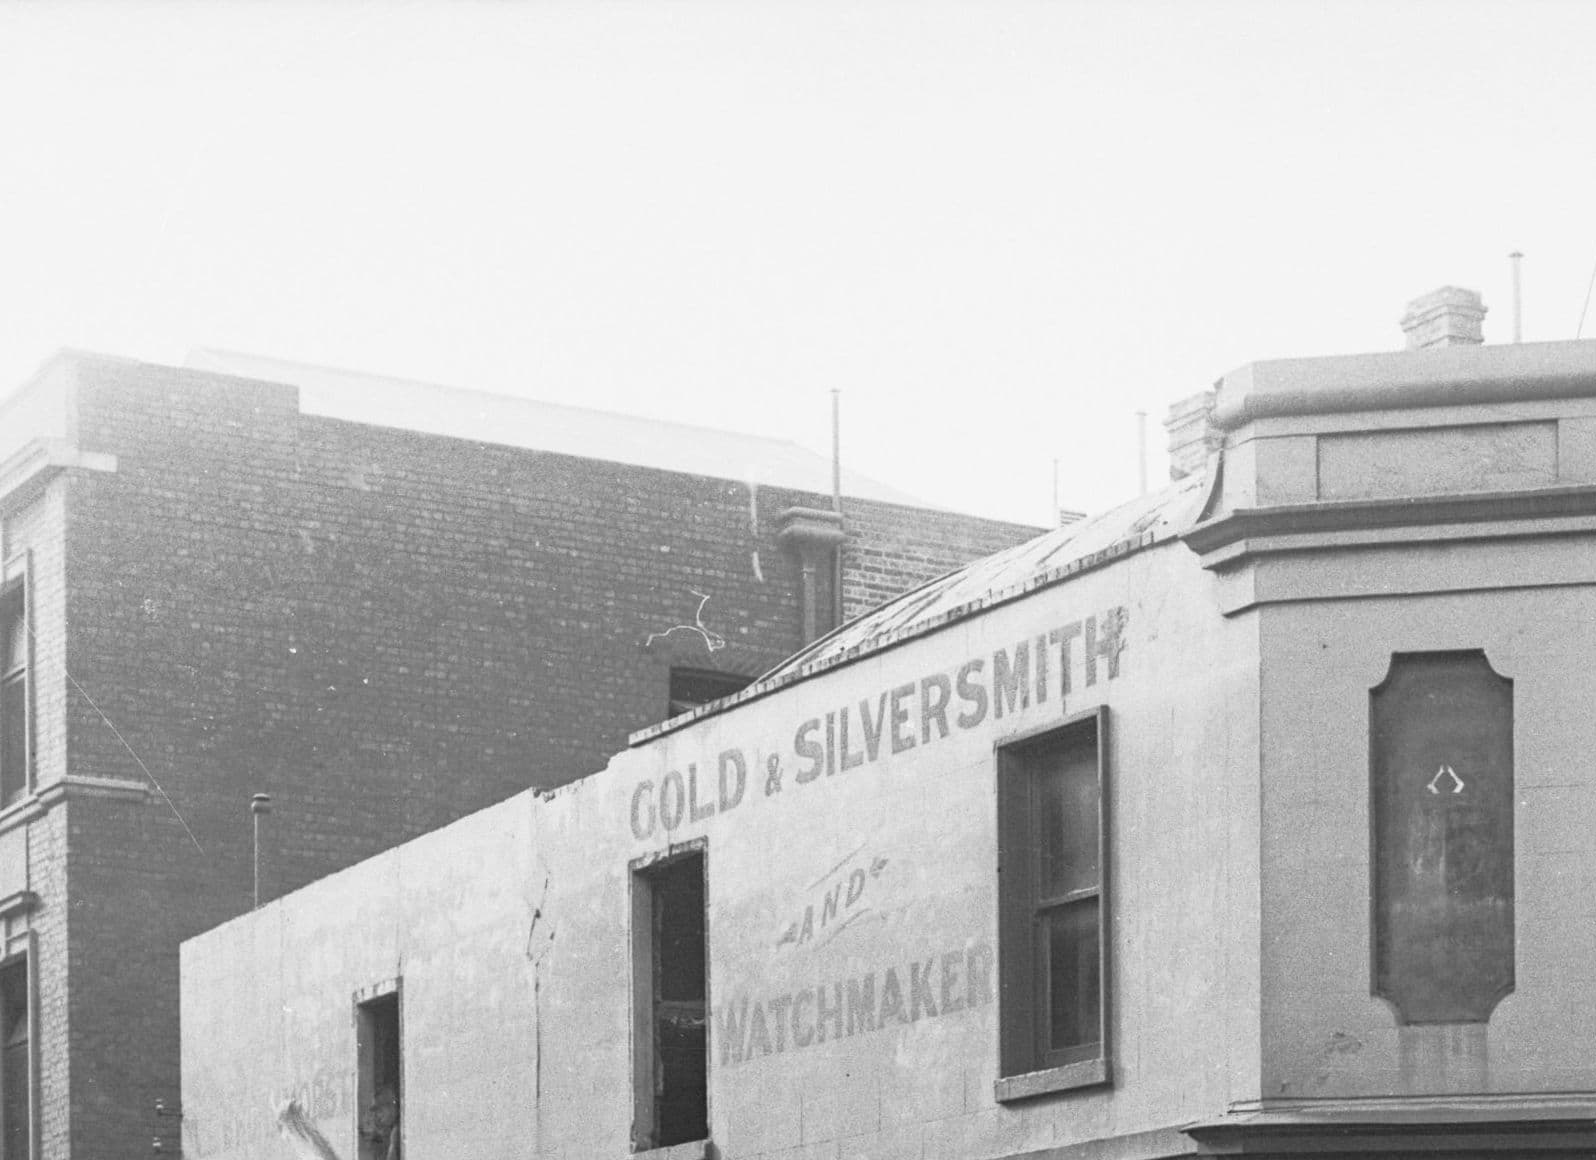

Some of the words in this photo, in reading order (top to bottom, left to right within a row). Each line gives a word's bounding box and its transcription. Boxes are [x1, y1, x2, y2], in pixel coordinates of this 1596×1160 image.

[629, 747, 748, 841] GOLD
[763, 751, 784, 798] &
[794, 604, 1130, 785] SILVERSMITH
[796, 866, 868, 946] AND
[714, 940, 995, 1069] WATCHMAKER
